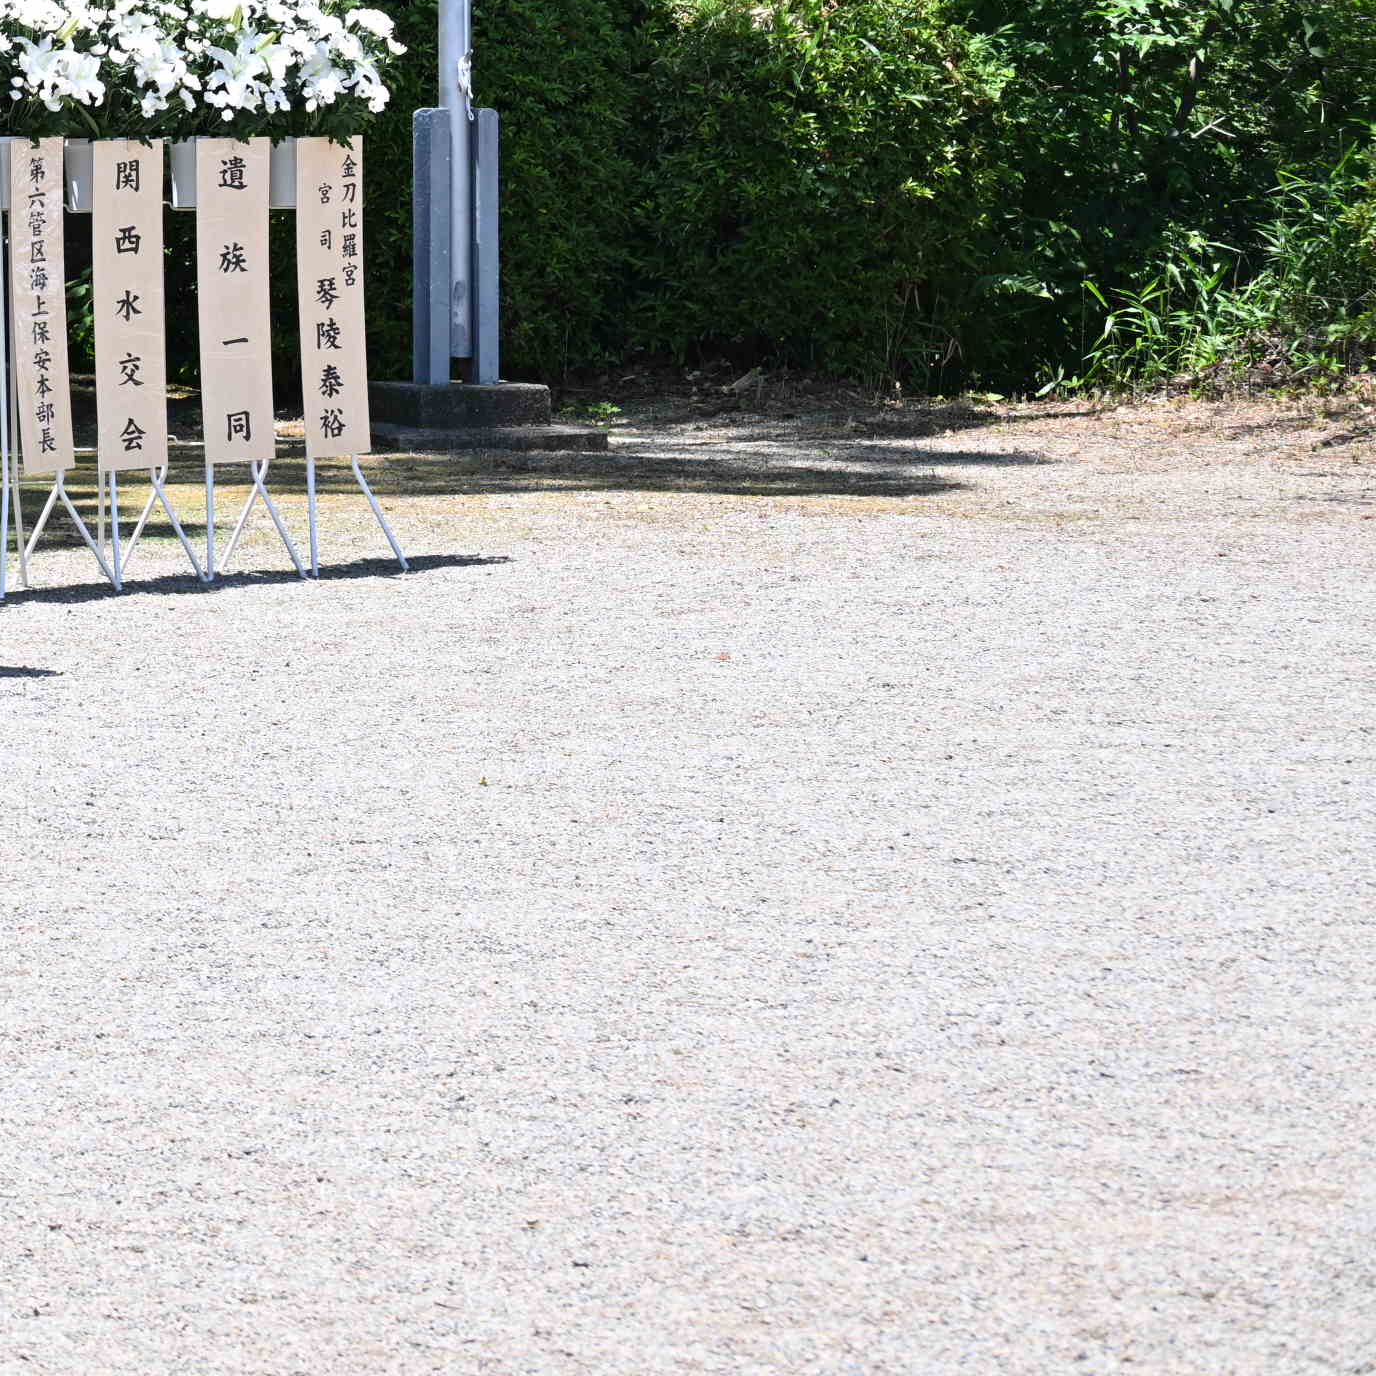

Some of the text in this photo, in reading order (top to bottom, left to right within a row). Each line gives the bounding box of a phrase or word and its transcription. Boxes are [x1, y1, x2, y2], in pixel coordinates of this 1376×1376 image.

[27, 156, 57, 454] 第六管区海上保安本部長
[114, 159, 147, 452] 関西水交会
[218, 155, 252, 442] 遺族一同
[318, 182, 333, 251] 宮司
[341, 153, 358, 288] 金刀比羅宮
